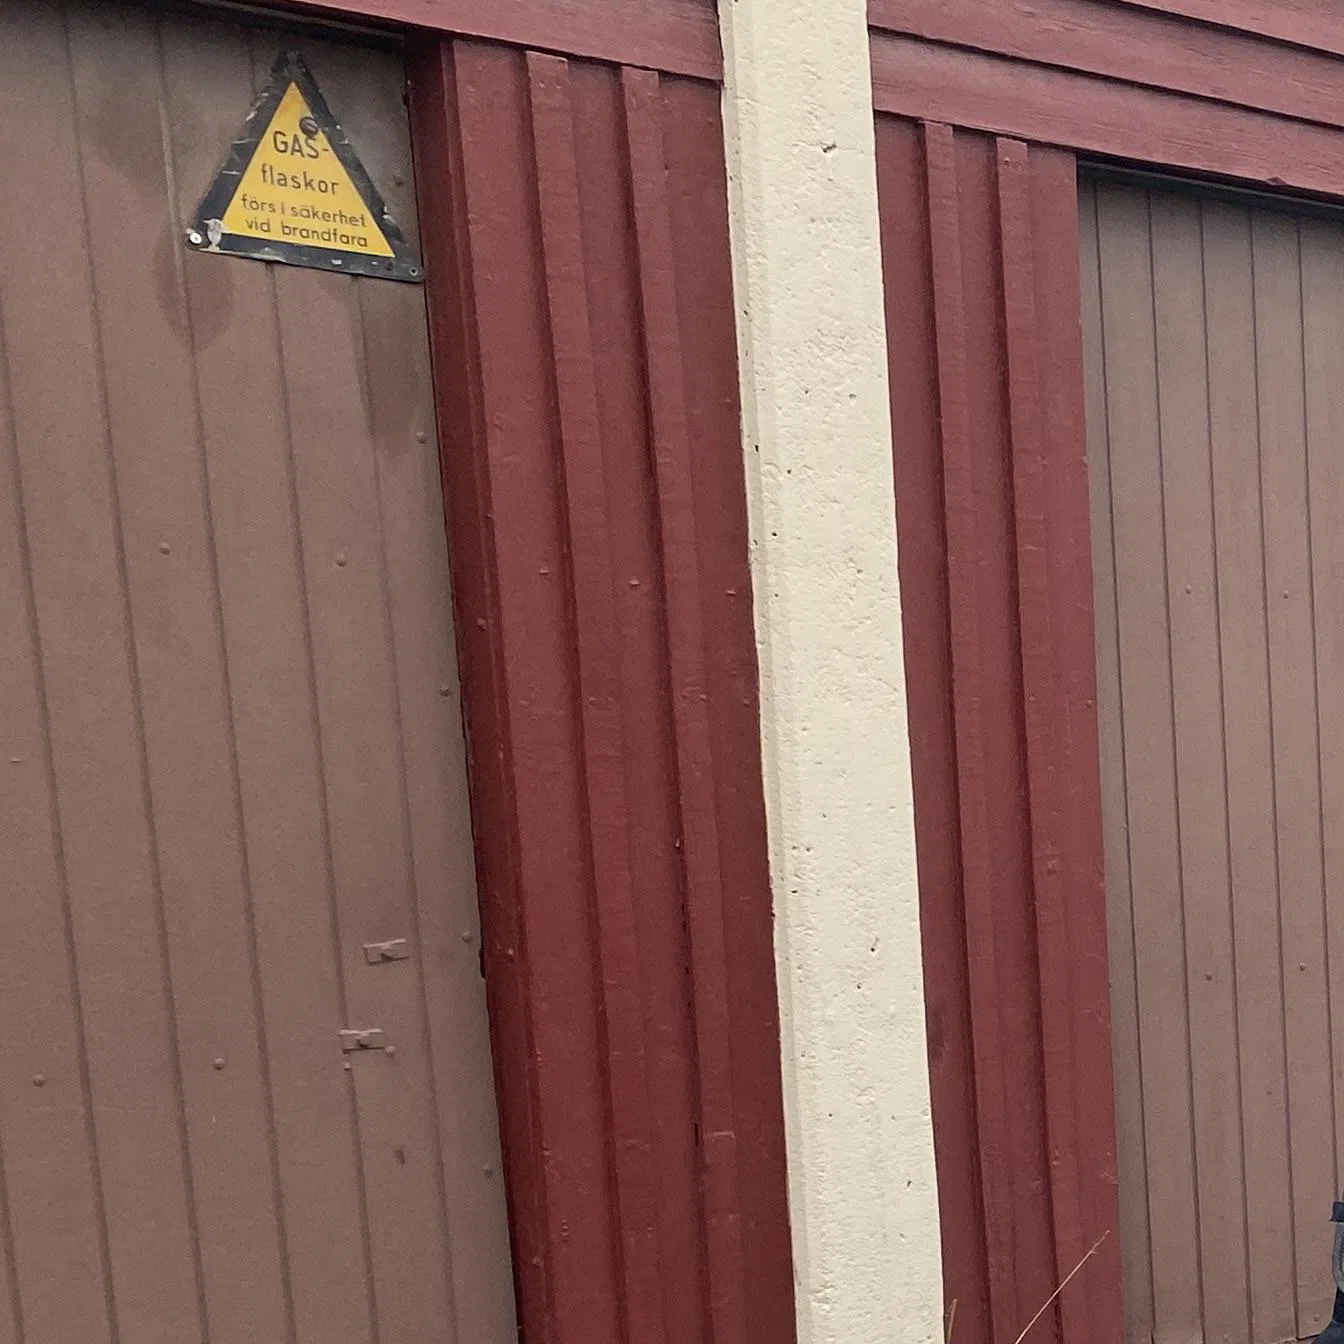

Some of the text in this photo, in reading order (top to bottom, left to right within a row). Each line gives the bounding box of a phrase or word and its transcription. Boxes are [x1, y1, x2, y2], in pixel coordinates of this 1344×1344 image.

[272, 130, 329, 159] GAS-
[261, 163, 340, 195] flaskor
[241, 193, 368, 227] förs i säkerhet
[244, 218, 368, 248] vid brandfara
